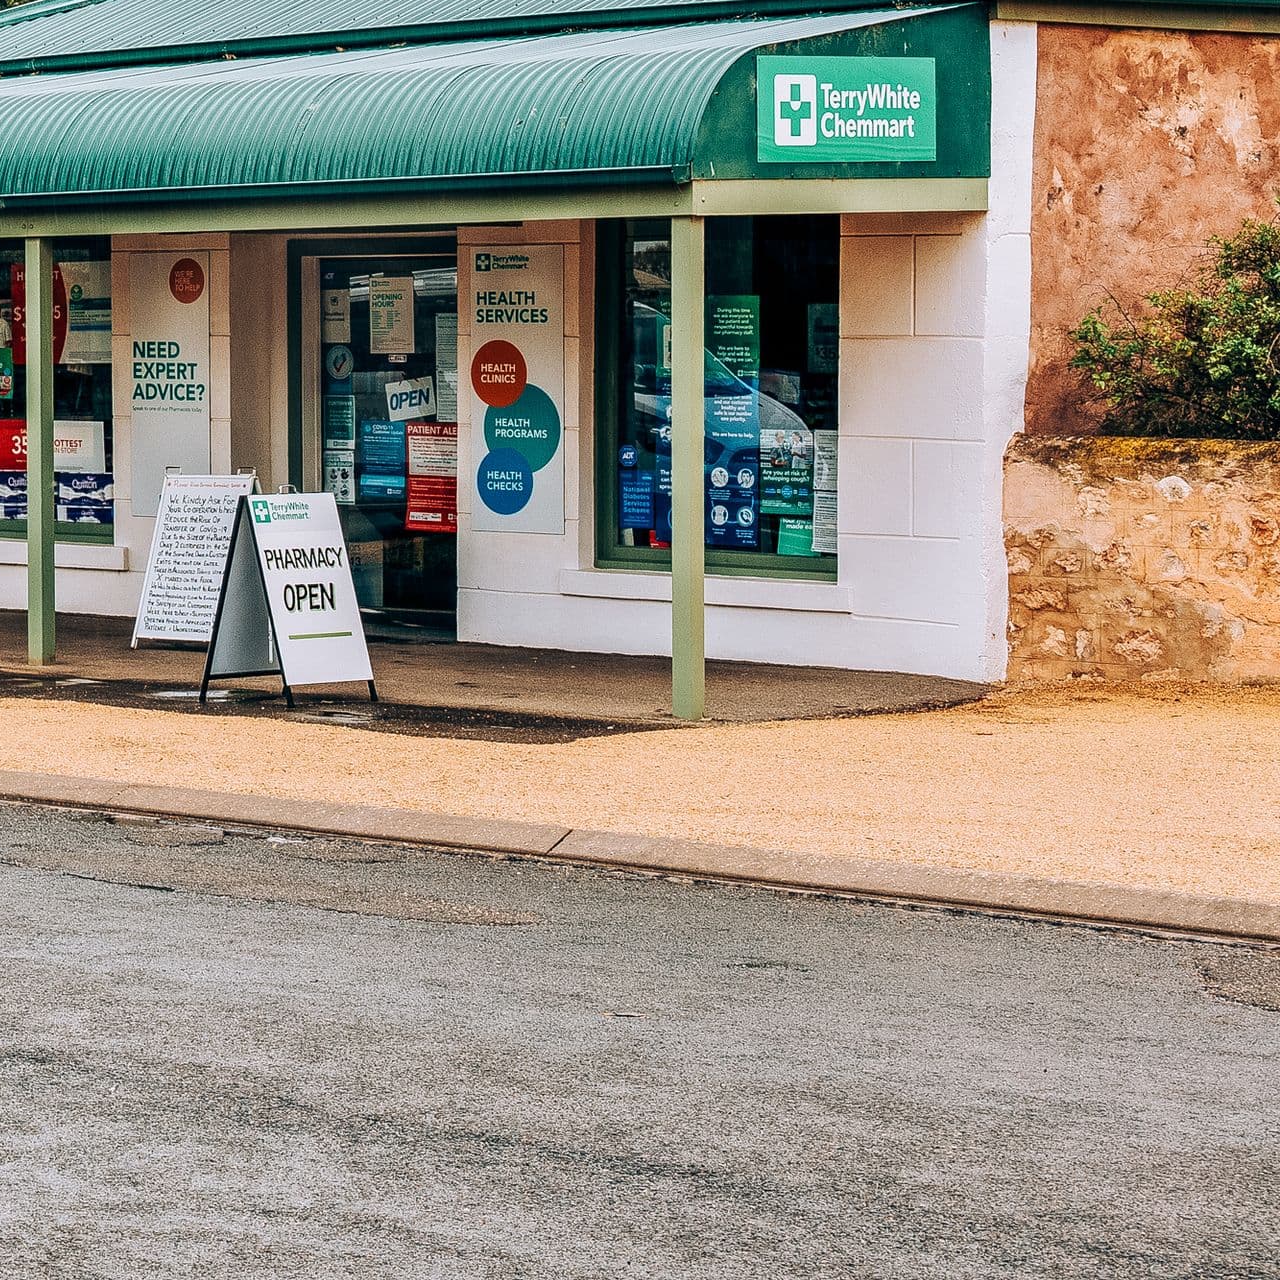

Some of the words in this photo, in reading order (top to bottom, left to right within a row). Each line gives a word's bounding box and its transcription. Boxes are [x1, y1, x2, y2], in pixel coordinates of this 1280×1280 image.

[820, 83, 921, 116] TerryWhite
[820, 112, 915, 138] Chemmart
[477, 291, 535, 305] HEALTH
[476, 308, 548, 323] SERVICES
[133, 341, 180, 358] NEED
[133, 362, 197, 379] EXPERT
[480, 364, 516, 373] HEALTH
[480, 374, 516, 383] CLINICS
[133, 383, 205, 401] ADVICE?
[390, 387, 430, 411] OPEN
[495, 418, 530, 428] HEALTH
[407, 425, 440, 435] PATIENT
[495, 429, 548, 439] PROGRAMS
[487, 471, 522, 480] HEALTH
[72, 479, 97, 489] Quilton
[487, 482, 523, 491] CHECKS
[270, 502, 310, 512] TerryWhite
[272, 512, 310, 520] Chemmart
[264, 547, 342, 570] PHARMACY
[284, 583, 336, 611] OPEN
